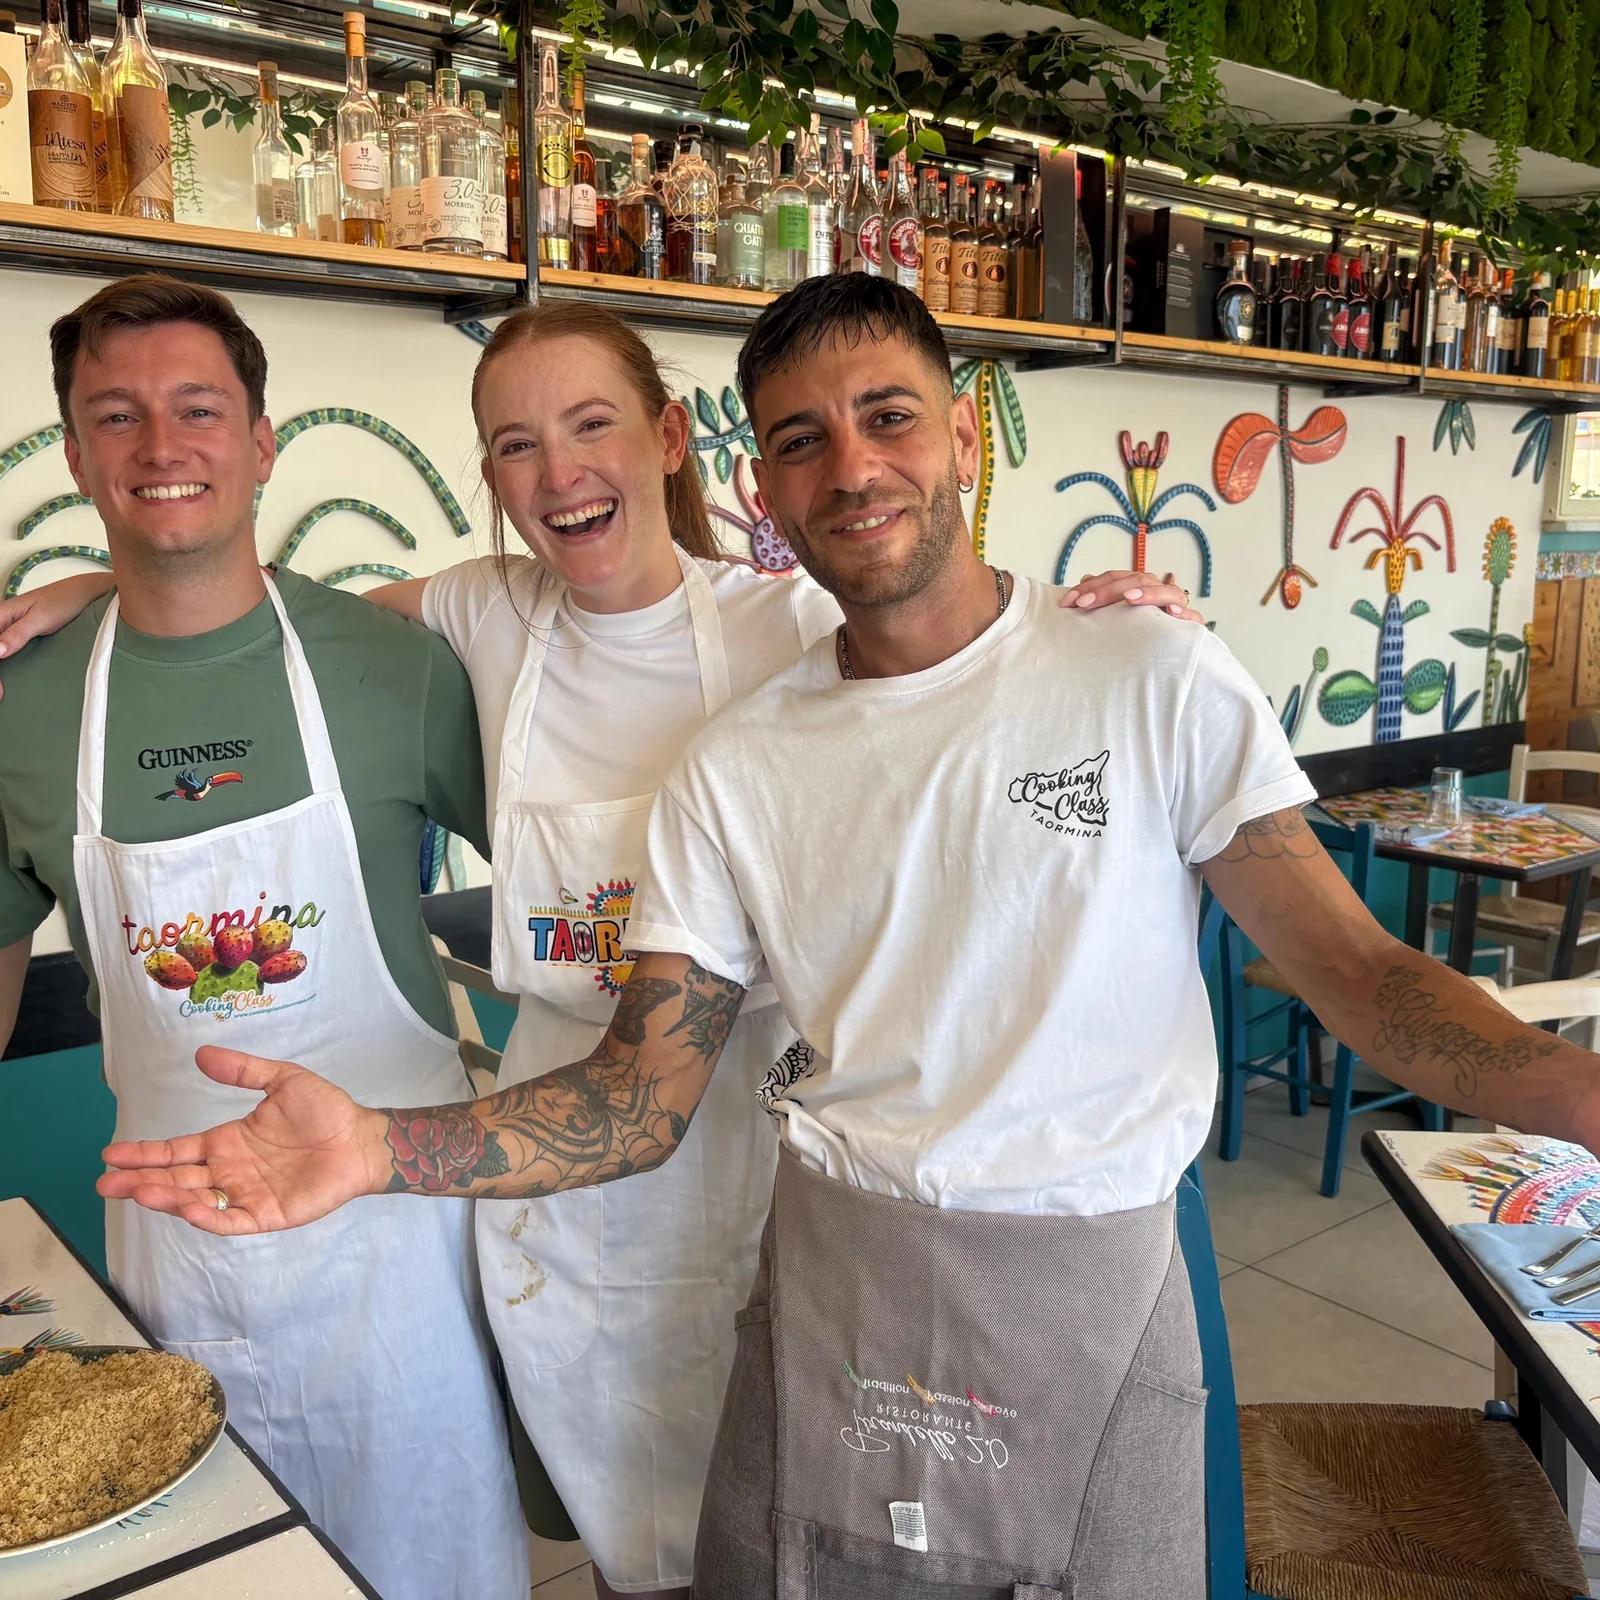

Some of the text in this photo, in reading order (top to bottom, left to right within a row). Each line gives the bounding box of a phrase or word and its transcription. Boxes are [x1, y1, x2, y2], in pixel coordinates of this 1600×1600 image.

[443, 201, 475, 210] MORBIDA
[1021, 768, 1101, 803] Cooking
[1054, 790, 1110, 821] Class
[1030, 808, 1103, 838] TAORMINA
[121, 891, 326, 955] taormina
[528, 917, 637, 964] TAOR
[178, 990, 276, 1020] Cooking Class
